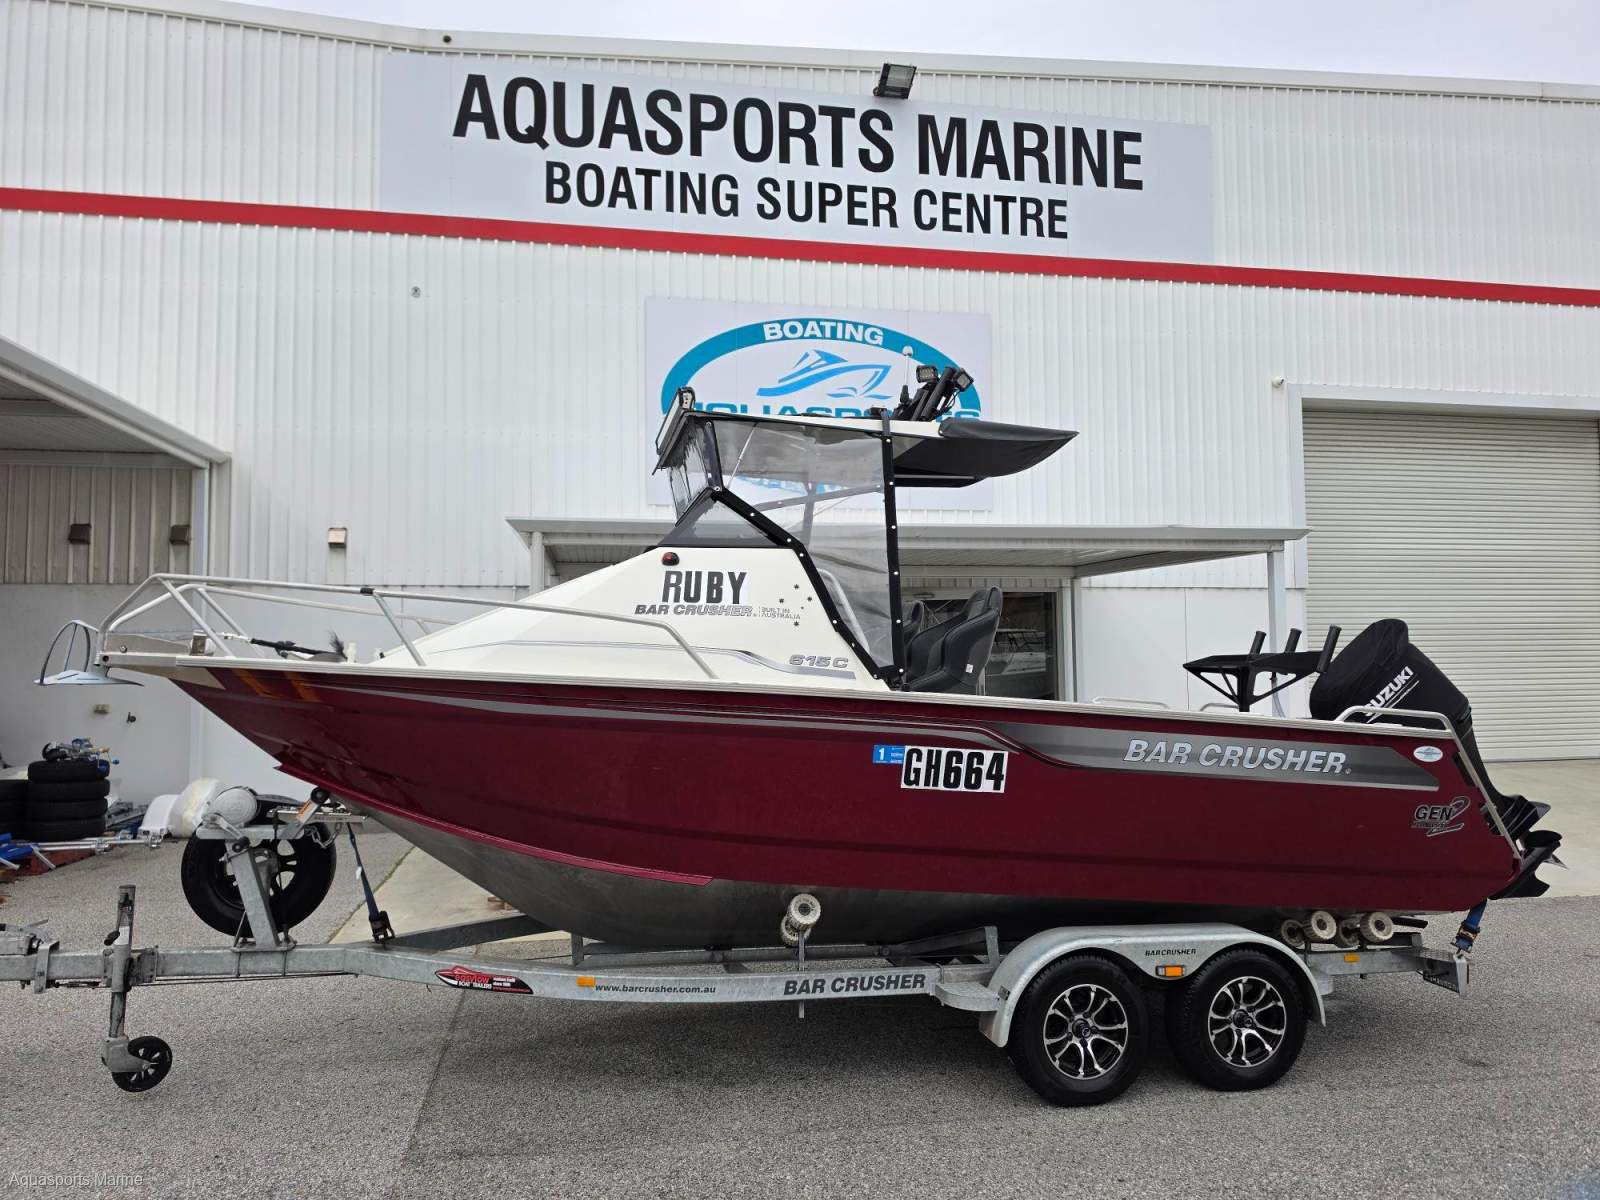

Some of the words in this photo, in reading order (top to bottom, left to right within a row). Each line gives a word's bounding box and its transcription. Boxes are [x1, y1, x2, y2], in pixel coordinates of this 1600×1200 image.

[453, 73, 895, 173] AQUASPORTS
[917, 113, 1144, 191] MARINE
[545, 160, 739, 218] BOATING
[756, 176, 899, 229] SUPER
[913, 188, 1068, 240] CENTRE
[762, 320, 884, 346] BOATING
[661, 570, 748, 605] RUBY
[634, 604, 671, 616] BAR
[673, 604, 753, 618] CRUSHER
[878, 747, 885, 761] 1
[903, 747, 1005, 791] GH664
[1123, 738, 1193, 765] BAR
[1199, 743, 1347, 775] CRUSHER
[595, 984, 717, 994] www.barcrusher.com.au
[783, 975, 828, 996] BAR
[830, 973, 926, 993] CRUSHER
